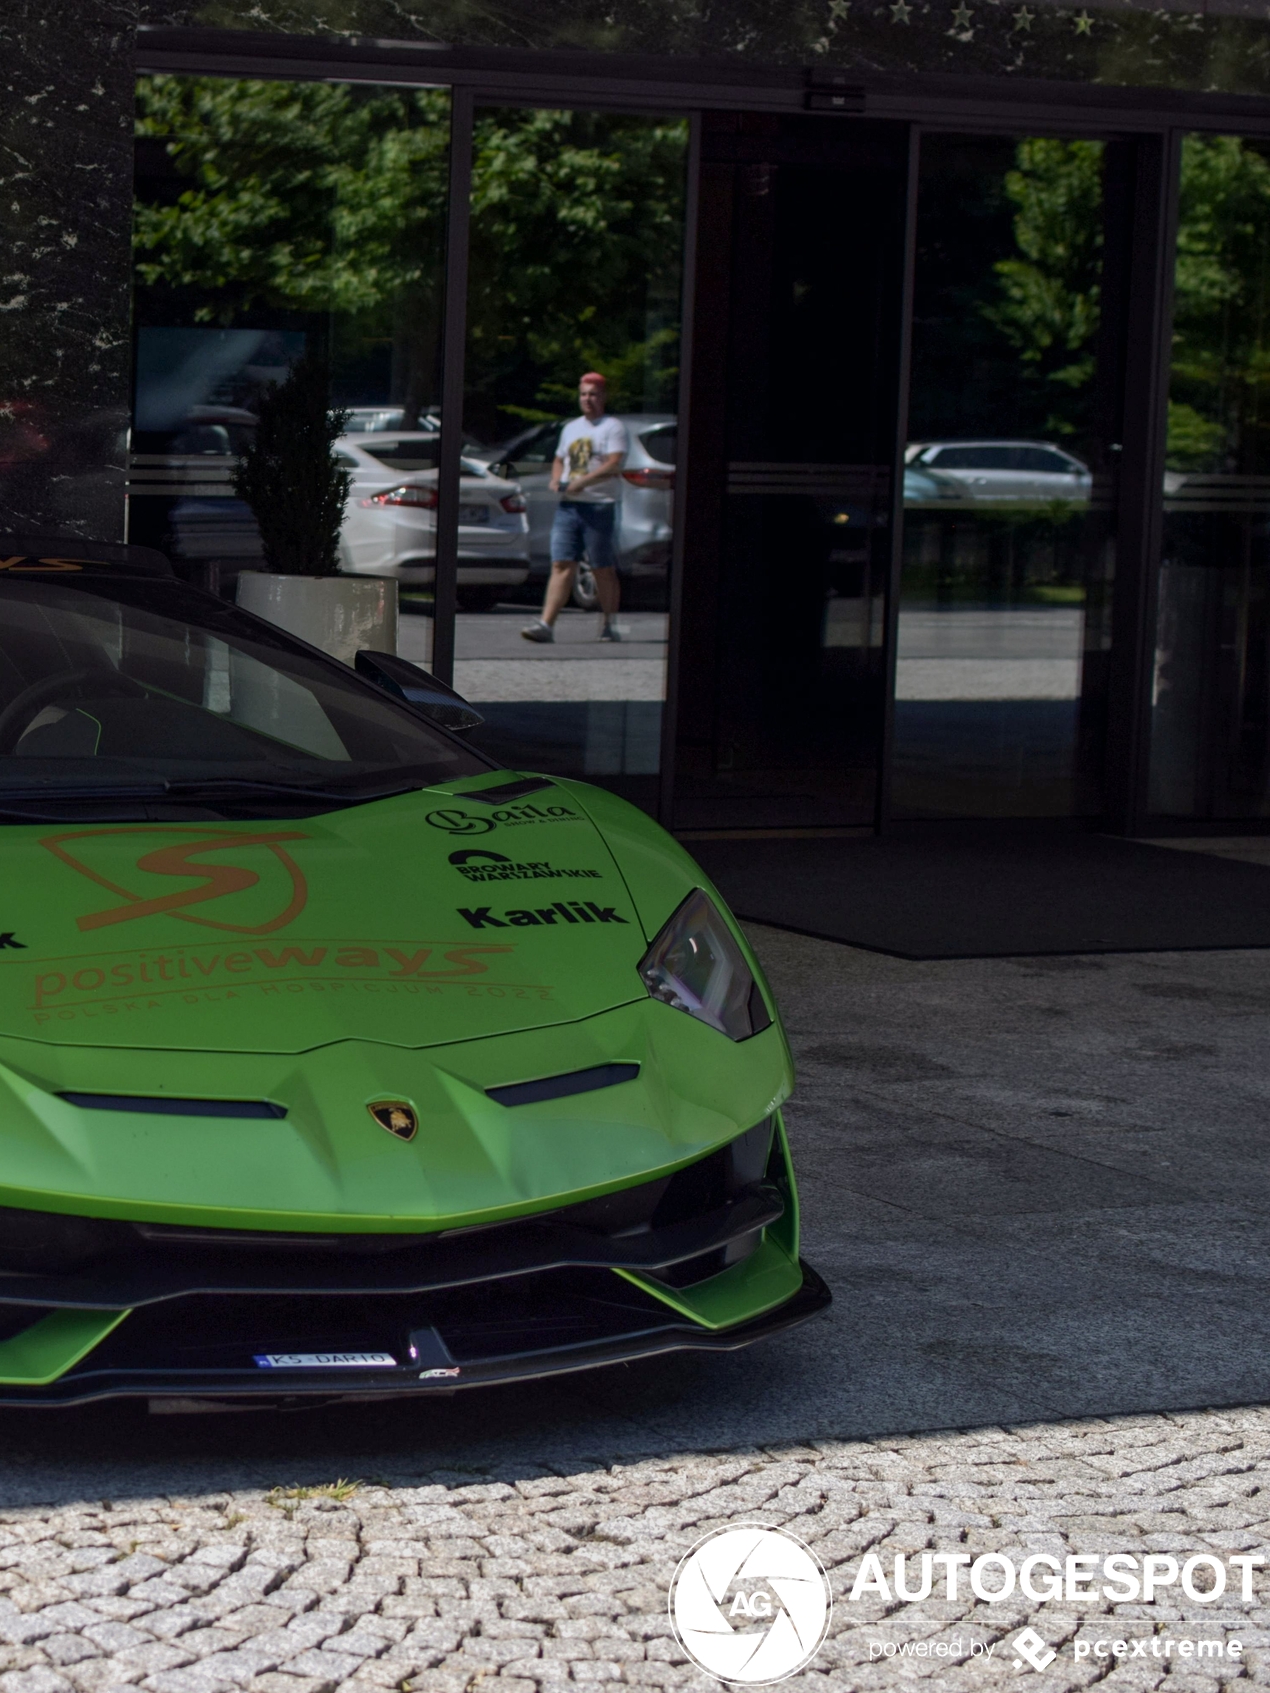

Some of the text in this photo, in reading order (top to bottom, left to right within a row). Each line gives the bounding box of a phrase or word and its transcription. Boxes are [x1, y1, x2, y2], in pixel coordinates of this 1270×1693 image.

[425, 804, 576, 835] Baila
[456, 862, 552, 875] BROWARY
[463, 869, 603, 882] WARSZAWSKIE
[456, 901, 629, 929] Karlik
[34, 946, 514, 1007] positiveways
[33, 999, 161, 1026] POLSKA
[184, 989, 241, 1004] DLA
[465, 985, 554, 1002] 2022
[315, 1354, 386, 1364] DARIO
